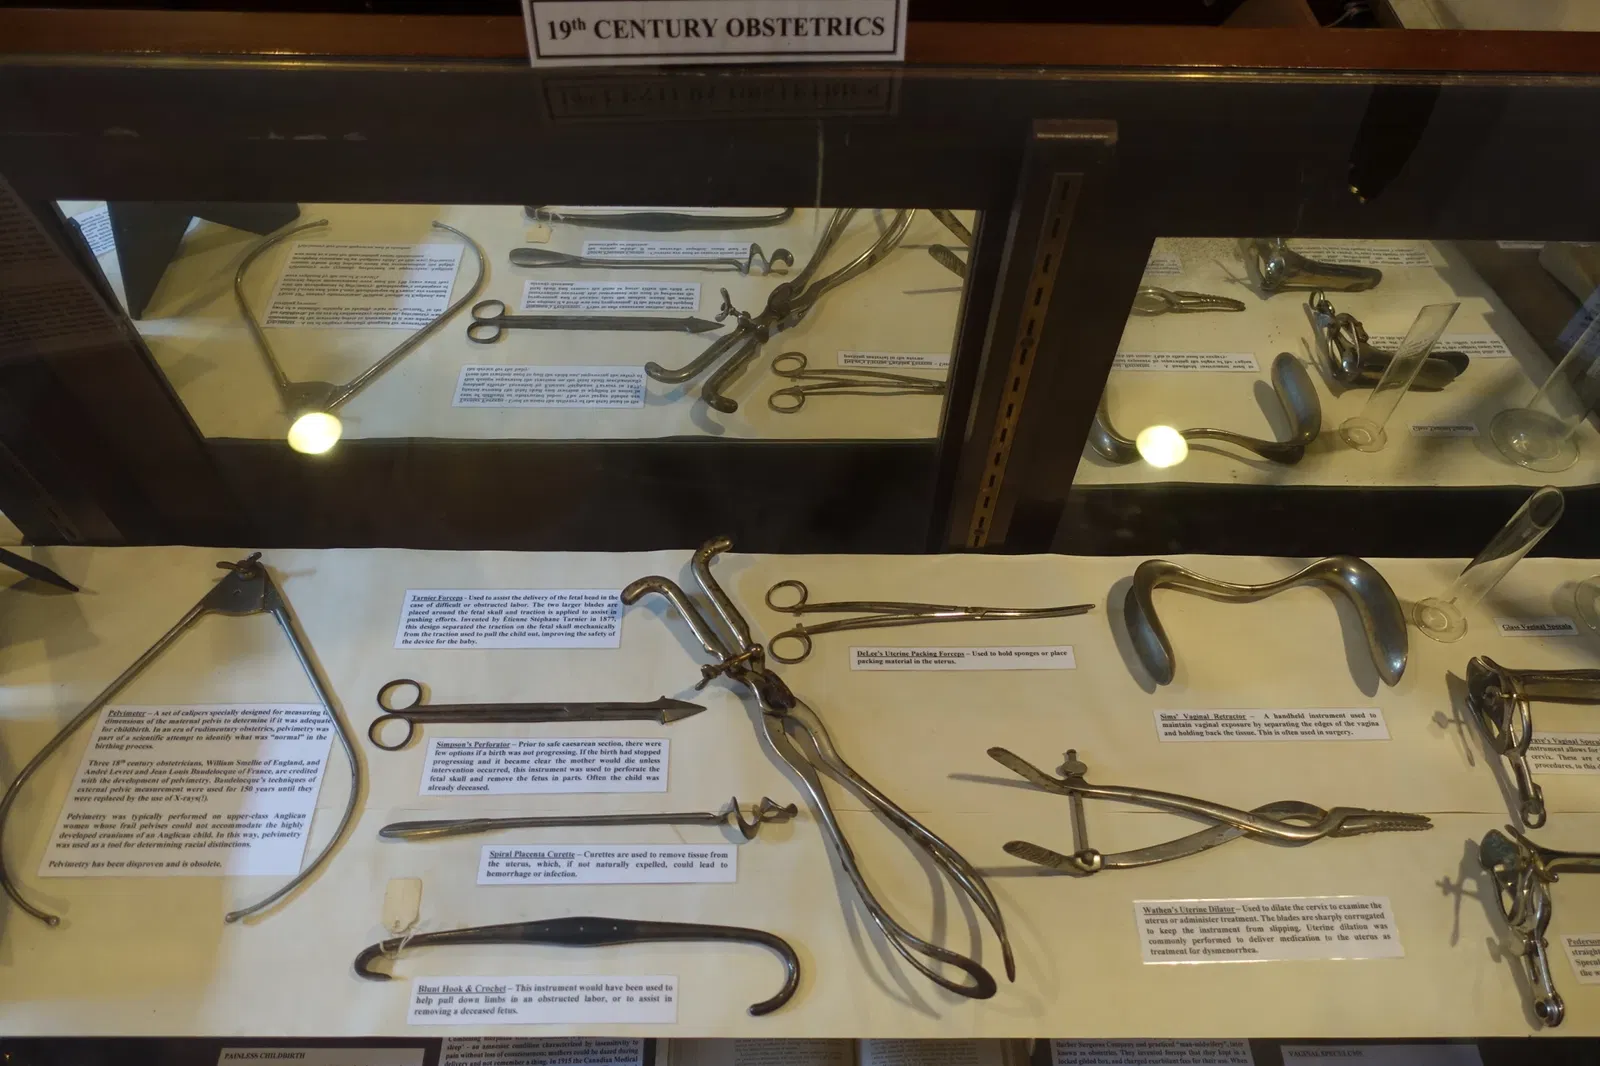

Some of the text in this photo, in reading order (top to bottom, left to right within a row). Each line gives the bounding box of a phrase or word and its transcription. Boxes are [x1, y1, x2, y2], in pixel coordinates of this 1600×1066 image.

[547, 16, 885, 40] 19th CENTURY OBSTETRICS
[180, 710, 209, 718] calipers
[125, 760, 155, 768] century
[489, 851, 512, 859] Spiral
[486, 870, 531, 879] hemorrhage
[1142, 905, 1178, 914] Wathen's
[1179, 905, 1207, 913] Uterine
[1208, 904, 1234, 912] Dilator
[1270, 903, 1291, 911] dilate
[1305, 902, 1328, 910] cervix
[1338, 902, 1369, 910] examine
[418, 984, 440, 993] Blunt
[441, 984, 463, 992] Hook
[474, 984, 506, 992] Crochet
[515, 984, 532, 992] This
[533, 984, 577, 992] instrument
[579, 984, 603, 992] would
[604, 984, 623, 992] have
[625, 984, 643, 992] been
[645, 984, 663, 992] used
[664, 984, 673, 992] to
[414, 1007, 451, 1017] removing
[460, 1007, 495, 1015] deceased
